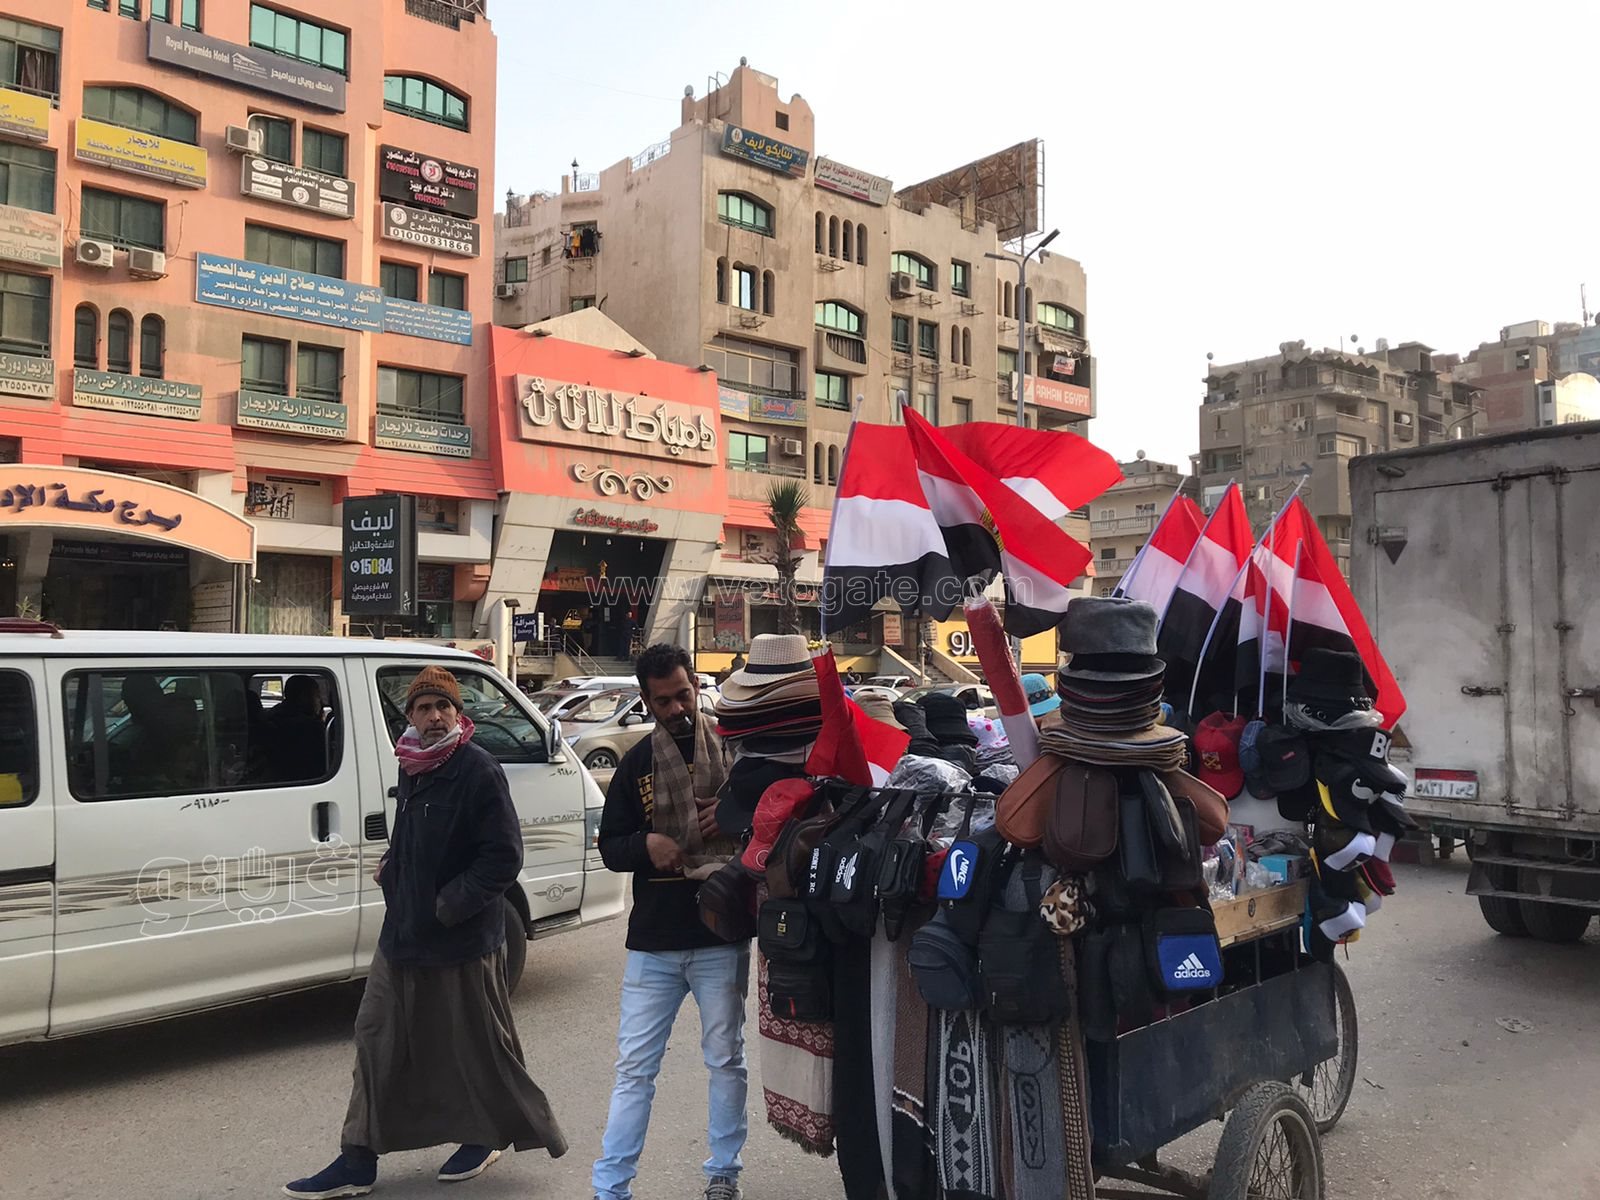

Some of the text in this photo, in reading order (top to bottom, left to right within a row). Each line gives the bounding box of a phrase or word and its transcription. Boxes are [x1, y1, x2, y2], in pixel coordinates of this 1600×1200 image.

[166, 36, 230, 64] Royal Pyramids Hotel
[297, 76, 315, 89] رويال
[316, 82, 334, 93] فندق
[745, 136, 765, 150] لايف
[766, 144, 793, 160] سايكو
[392, 227, 470, 251] 01000831866
[259, 272, 287, 287] الدين
[290, 275, 315, 291] صلاح
[318, 281, 346, 298] محمد
[354, 287, 382, 305] دكتور
[7, 361, 21, 375] دور
[1064, 391, 1089, 407] EGYPT
[282, 399, 311, 421] إدارية
[313, 404, 346, 423] وحدات
[414, 422, 439, 438] طبية
[625, 397, 717, 455] دمياط
[439, 426, 470, 443] وحدات
[115, 500, 182, 531] برج
[350, 508, 394, 537] لايف
[360, 558, 393, 575] 15084
[352, 583, 369, 592] فيصل
[380, 582, 390, 590] ٨٧
[515, 617, 536, 628] صرافة
[194, 798, 220, 809] ٩٦٨٥
[835, 856, 847, 883] adidas
[957, 857, 970, 885] NIKE
[1174, 968, 1211, 979] adidas
[1020, 1080, 1039, 1161] SKY
